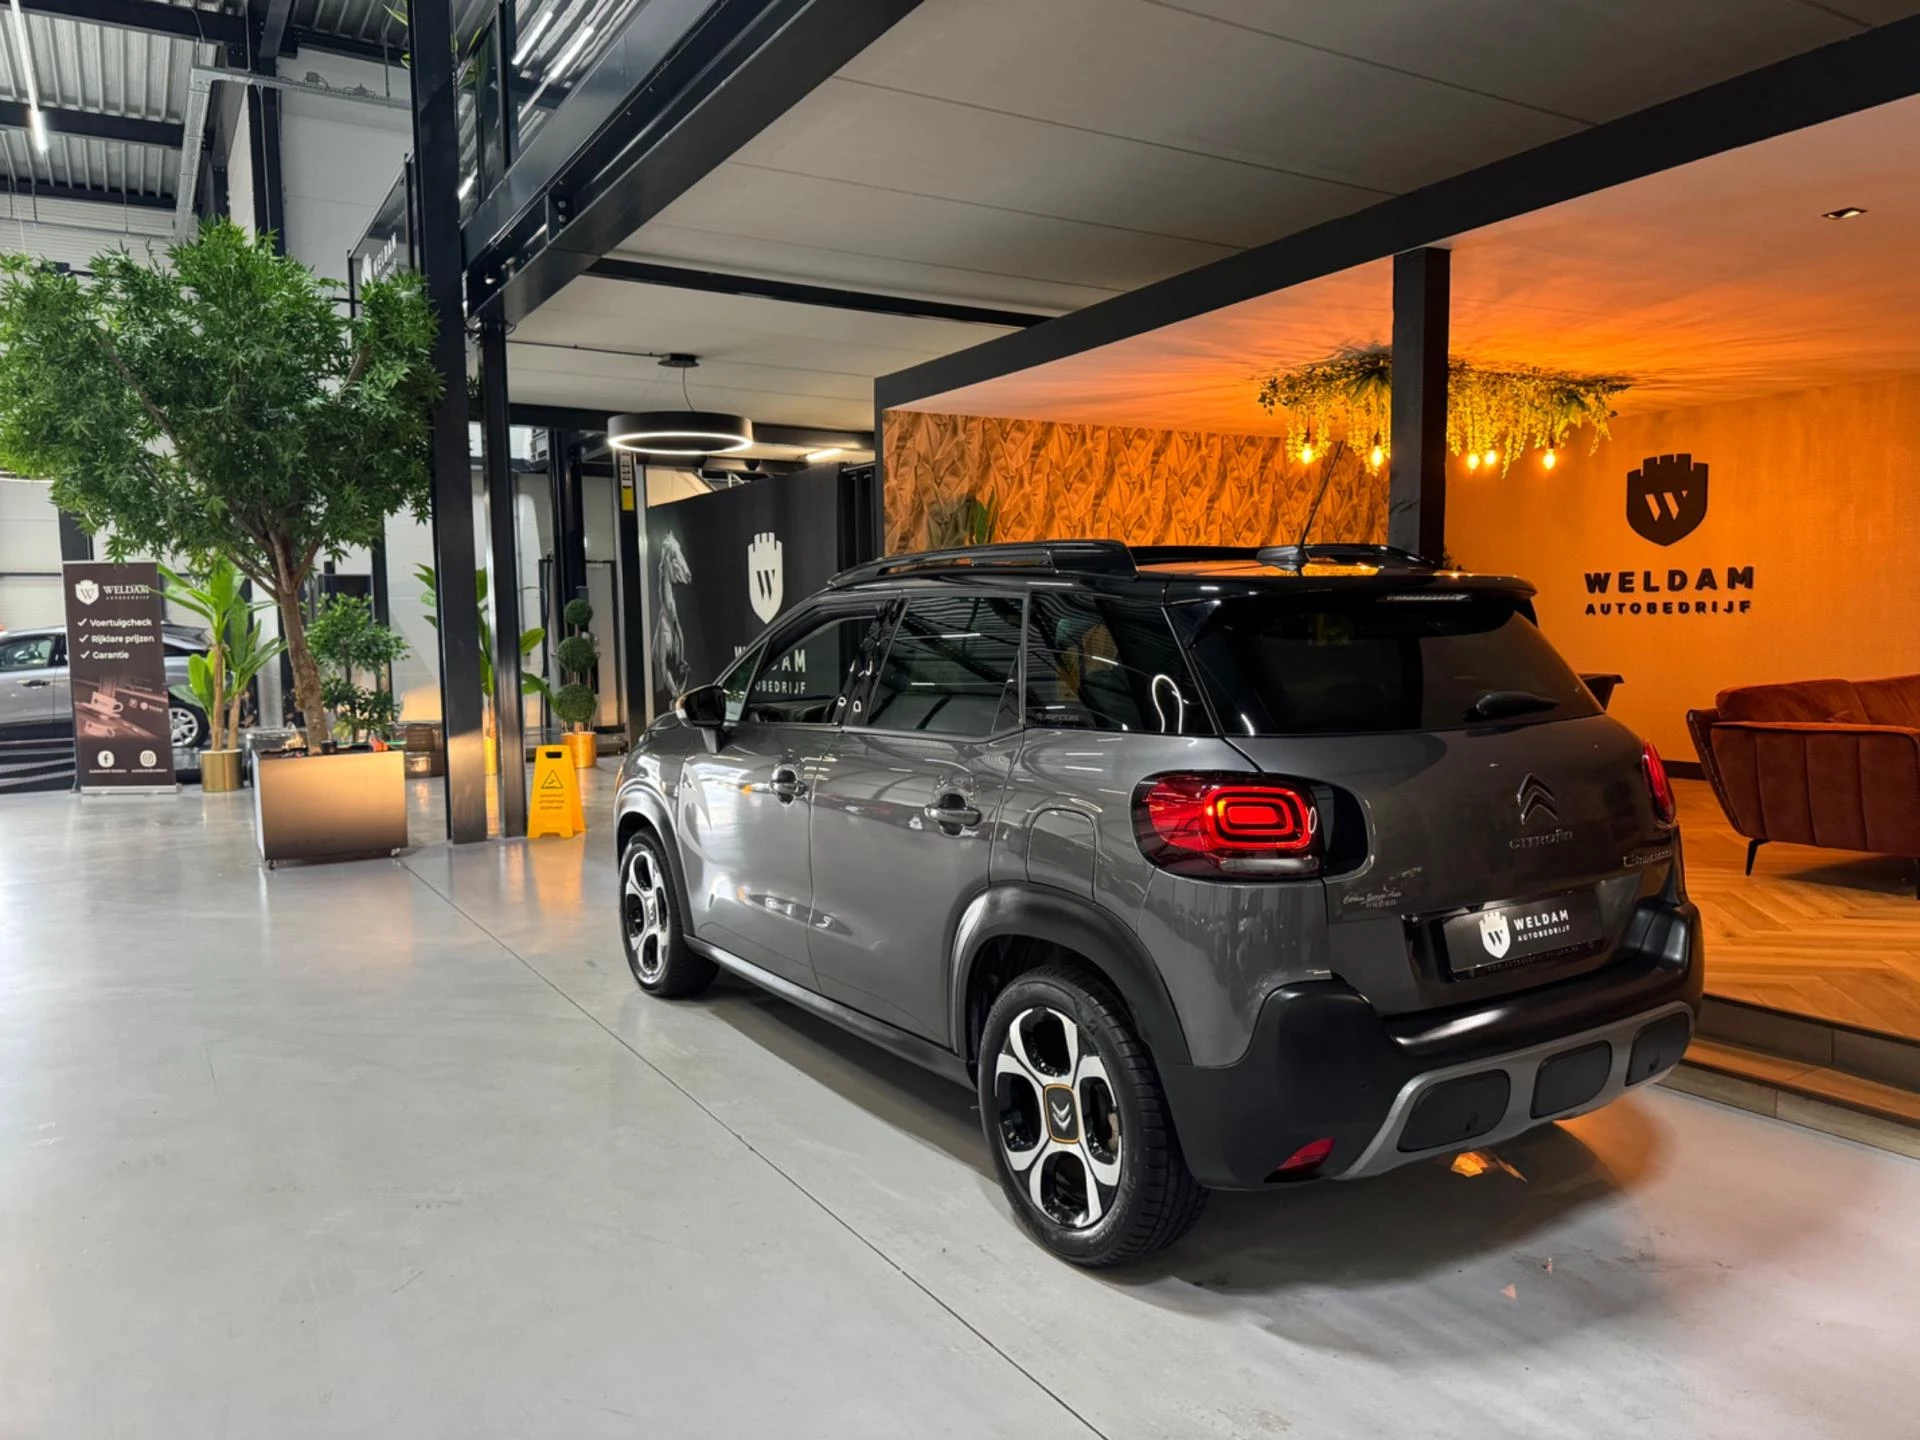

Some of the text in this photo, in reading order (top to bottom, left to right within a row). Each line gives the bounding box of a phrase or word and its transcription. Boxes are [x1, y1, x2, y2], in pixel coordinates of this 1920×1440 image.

[1584, 566, 1754, 594] WELDAM
[102, 584, 149, 594] WELDAM
[1585, 600, 1751, 615] AUTOBEDRIJF
[89, 618, 152, 628] Voertuigcheck
[91, 634, 155, 645] Rijklare prijzen
[92, 650, 130, 660] Garantie
[1513, 909, 1569, 931] WELDAM
[1517, 925, 1570, 942] AUTOBEDRIJF
